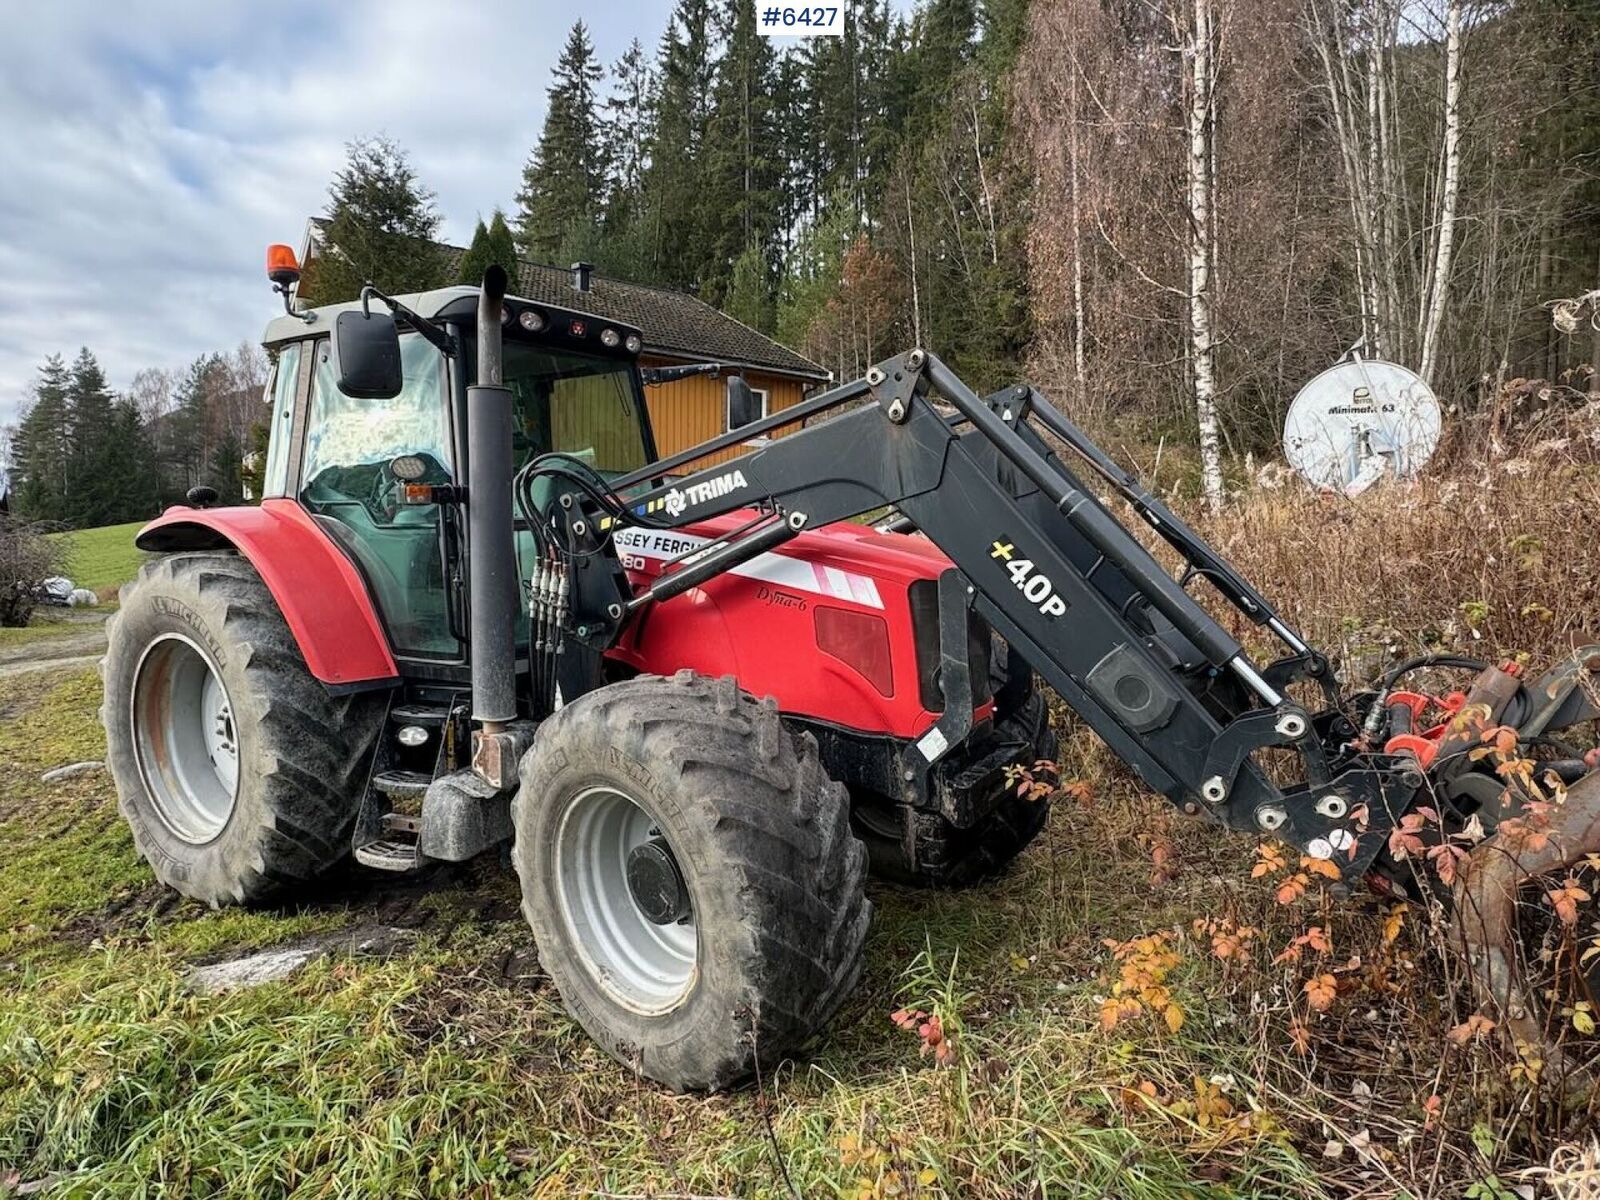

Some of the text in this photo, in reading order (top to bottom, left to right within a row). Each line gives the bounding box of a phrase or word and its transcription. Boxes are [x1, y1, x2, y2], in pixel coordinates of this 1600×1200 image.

[1382, 404, 1395, 413] 63
[685, 470, 748, 505] TRIMA
[615, 532, 651, 548] SSEY
[622, 556, 646, 570] 80
[756, 587, 807, 611] Dyna-6
